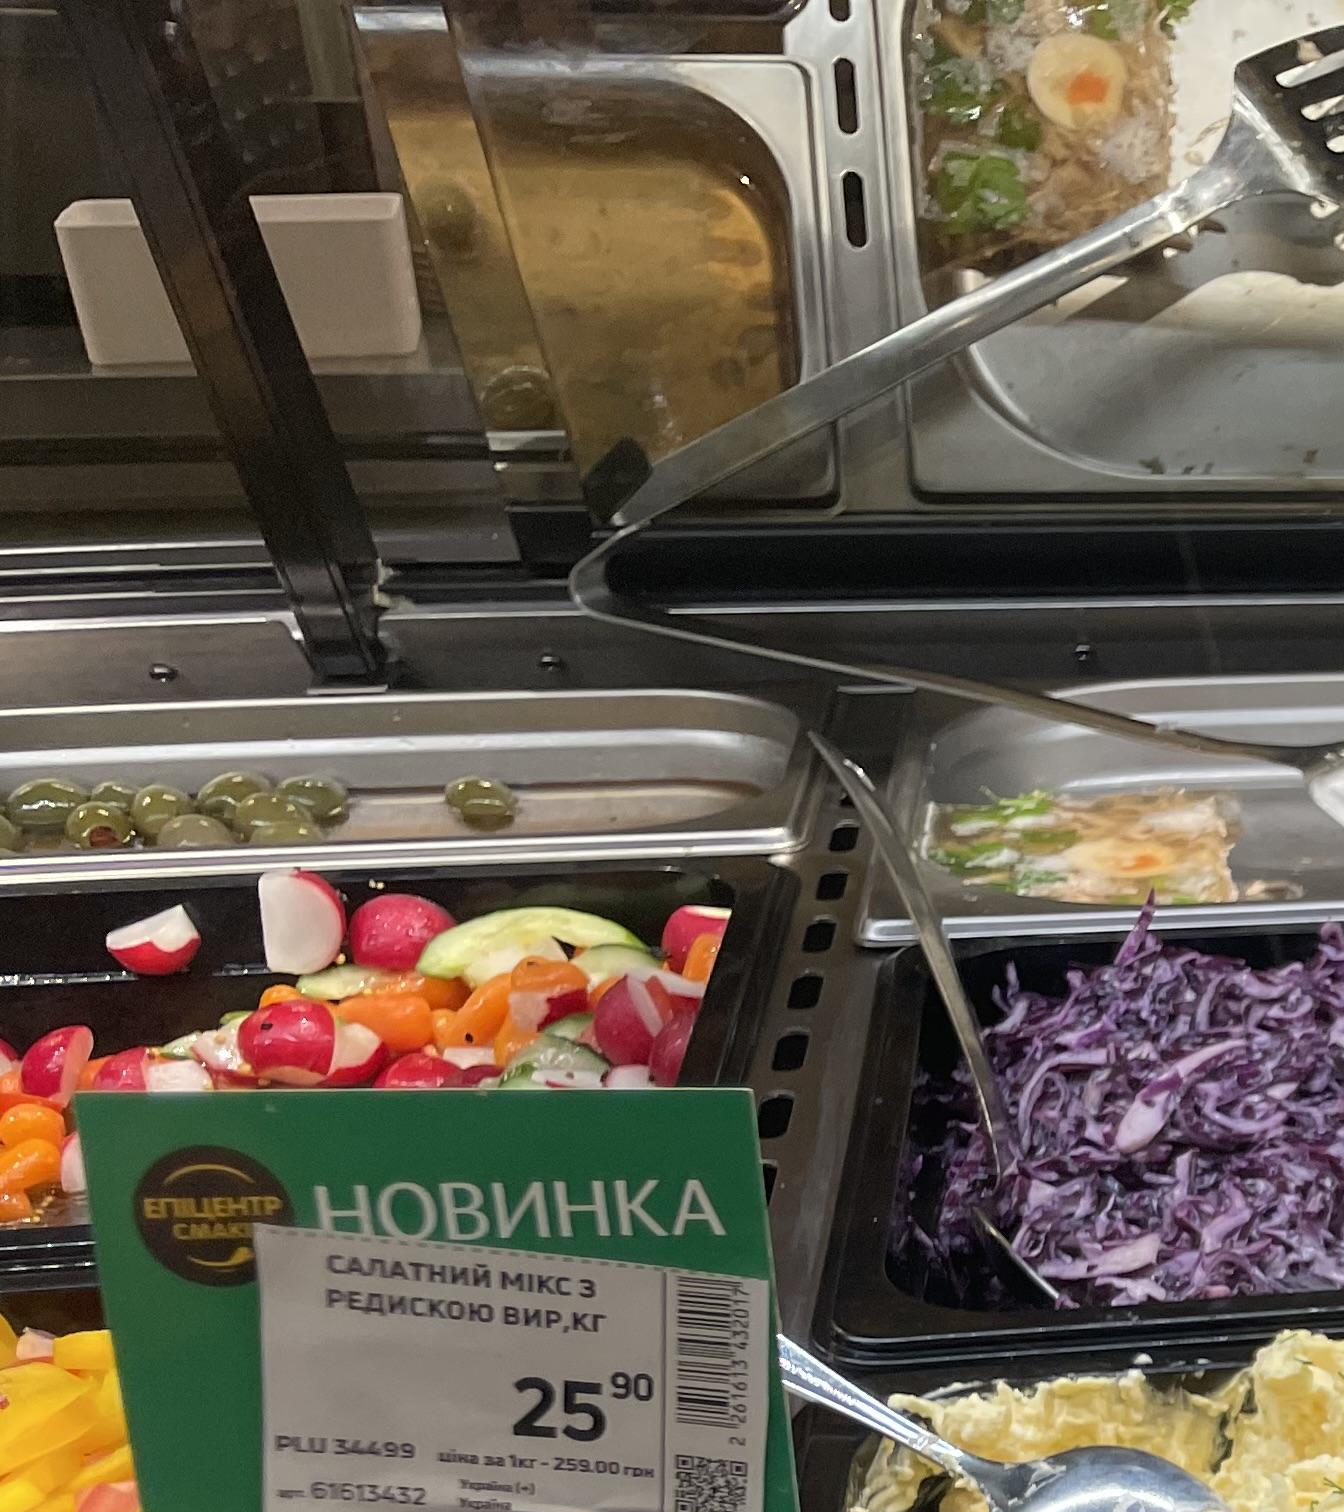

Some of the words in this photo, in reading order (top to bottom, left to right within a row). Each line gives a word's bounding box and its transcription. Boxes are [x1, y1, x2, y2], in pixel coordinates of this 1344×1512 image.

[313, 1179, 727, 1241] НОВИНКА
[326, 1254, 492, 1288] САЛАТНИЙ
[501, 1271, 571, 1295] МІКС
[325, 1289, 494, 1323] РЕДИСКОЮ
[503, 1306, 607, 1333] ВИР,КГ
[513, 1376, 606, 1442] 25
[611, 1371, 654, 1401] 90
[275, 1435, 328, 1453] PLU
[332, 1438, 416, 1458] 34499
[310, 1481, 426, 1505] 61613432
